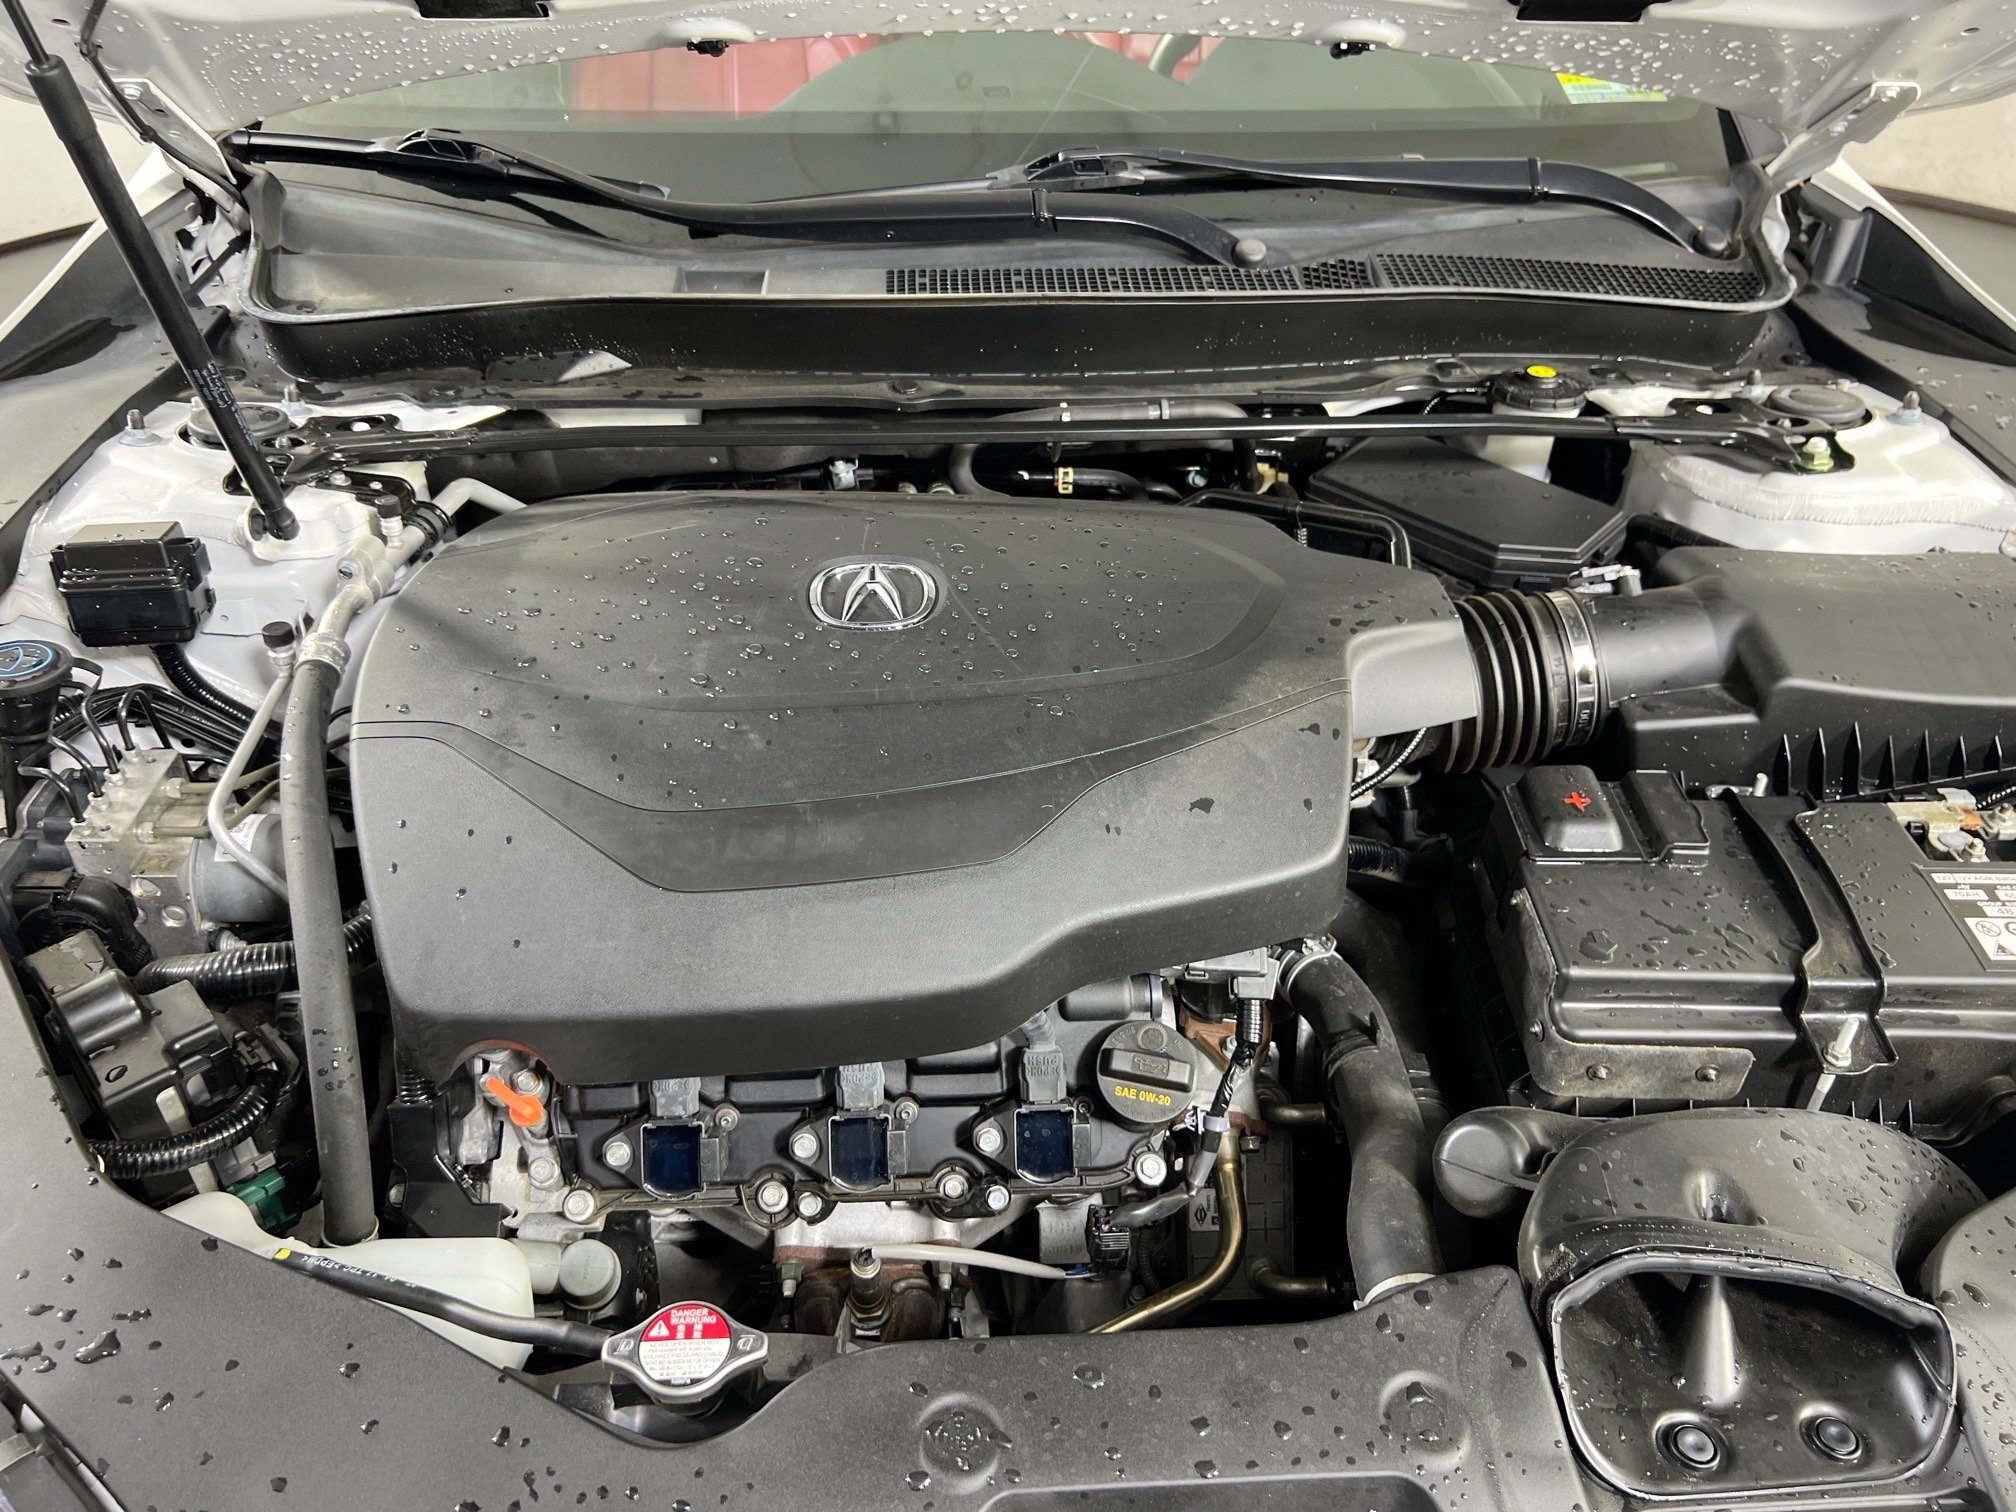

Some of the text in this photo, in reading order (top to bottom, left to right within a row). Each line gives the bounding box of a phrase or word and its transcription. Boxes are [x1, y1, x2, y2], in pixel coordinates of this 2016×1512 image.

[1027, 1055, 1057, 1066] PUSH
[1115, 1085, 1172, 1107] SAE 0W-20
[671, 1308, 709, 1317] DANGER
[670, 1315, 717, 1325] WARNUNG
